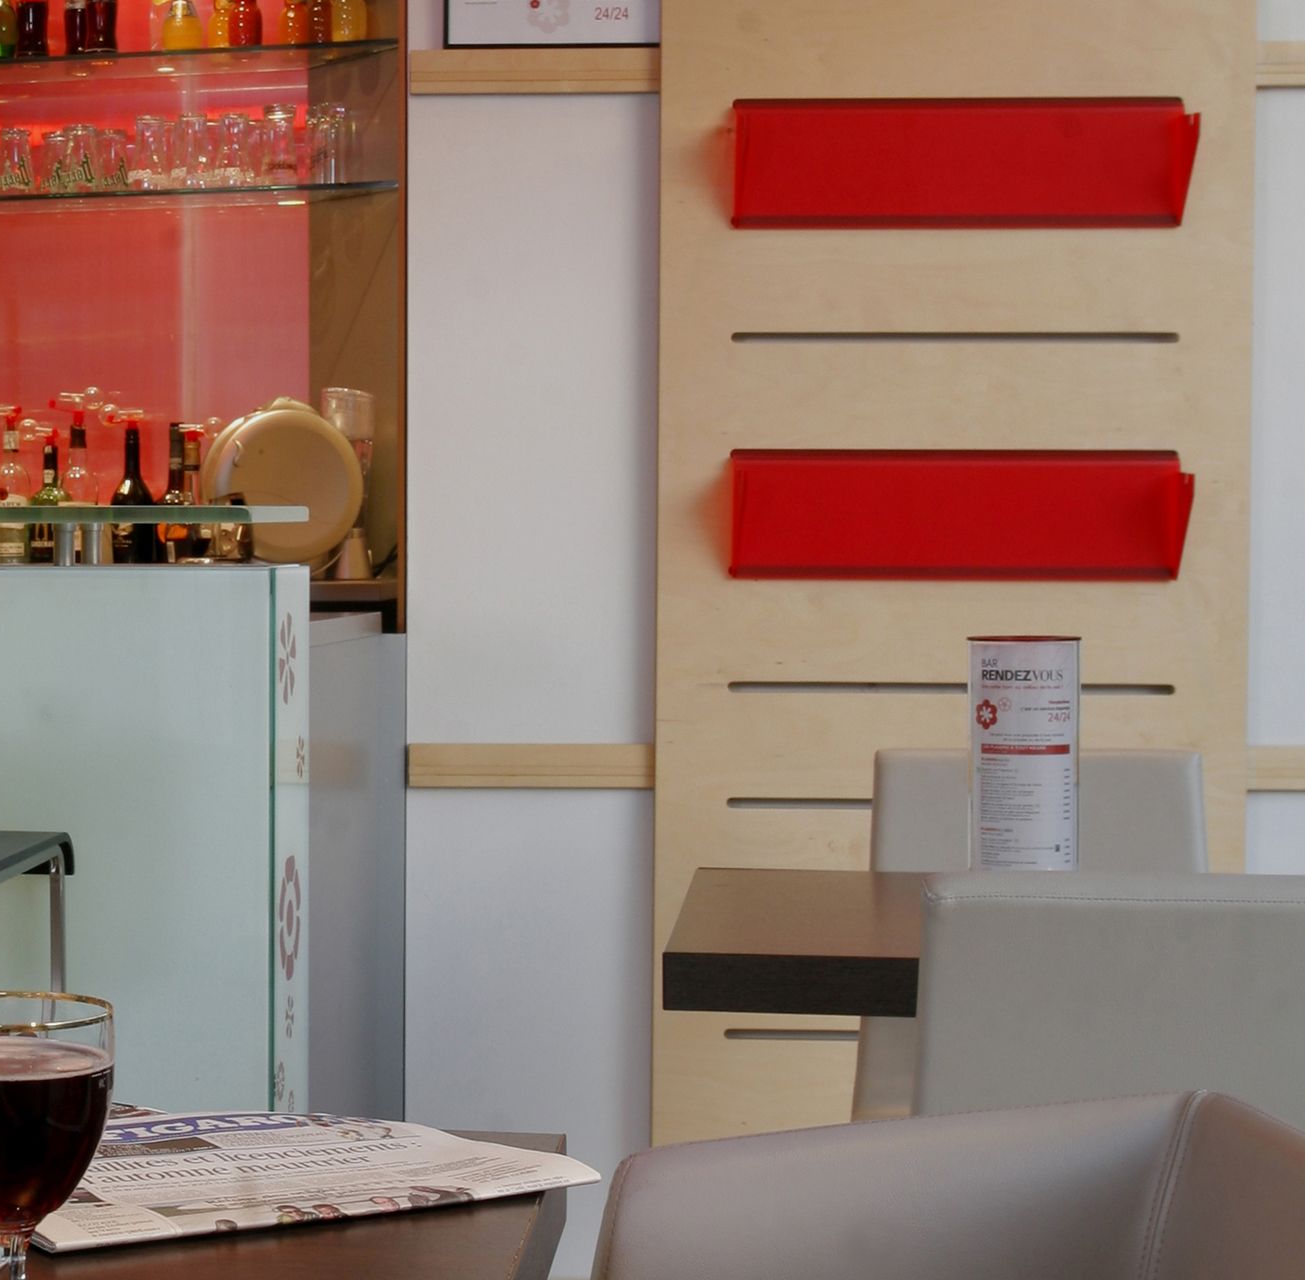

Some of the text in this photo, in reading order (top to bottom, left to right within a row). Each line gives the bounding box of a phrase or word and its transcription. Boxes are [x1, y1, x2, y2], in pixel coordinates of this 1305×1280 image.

[594, 6, 629, 20] 24/24
[982, 658, 997, 668] BAR
[982, 669, 1063, 681] RENDEZVOUS
[183, 1153, 211, 1164] et
[214, 1140, 408, 1163] licenciements
[236, 1154, 371, 1174] meurtrier
